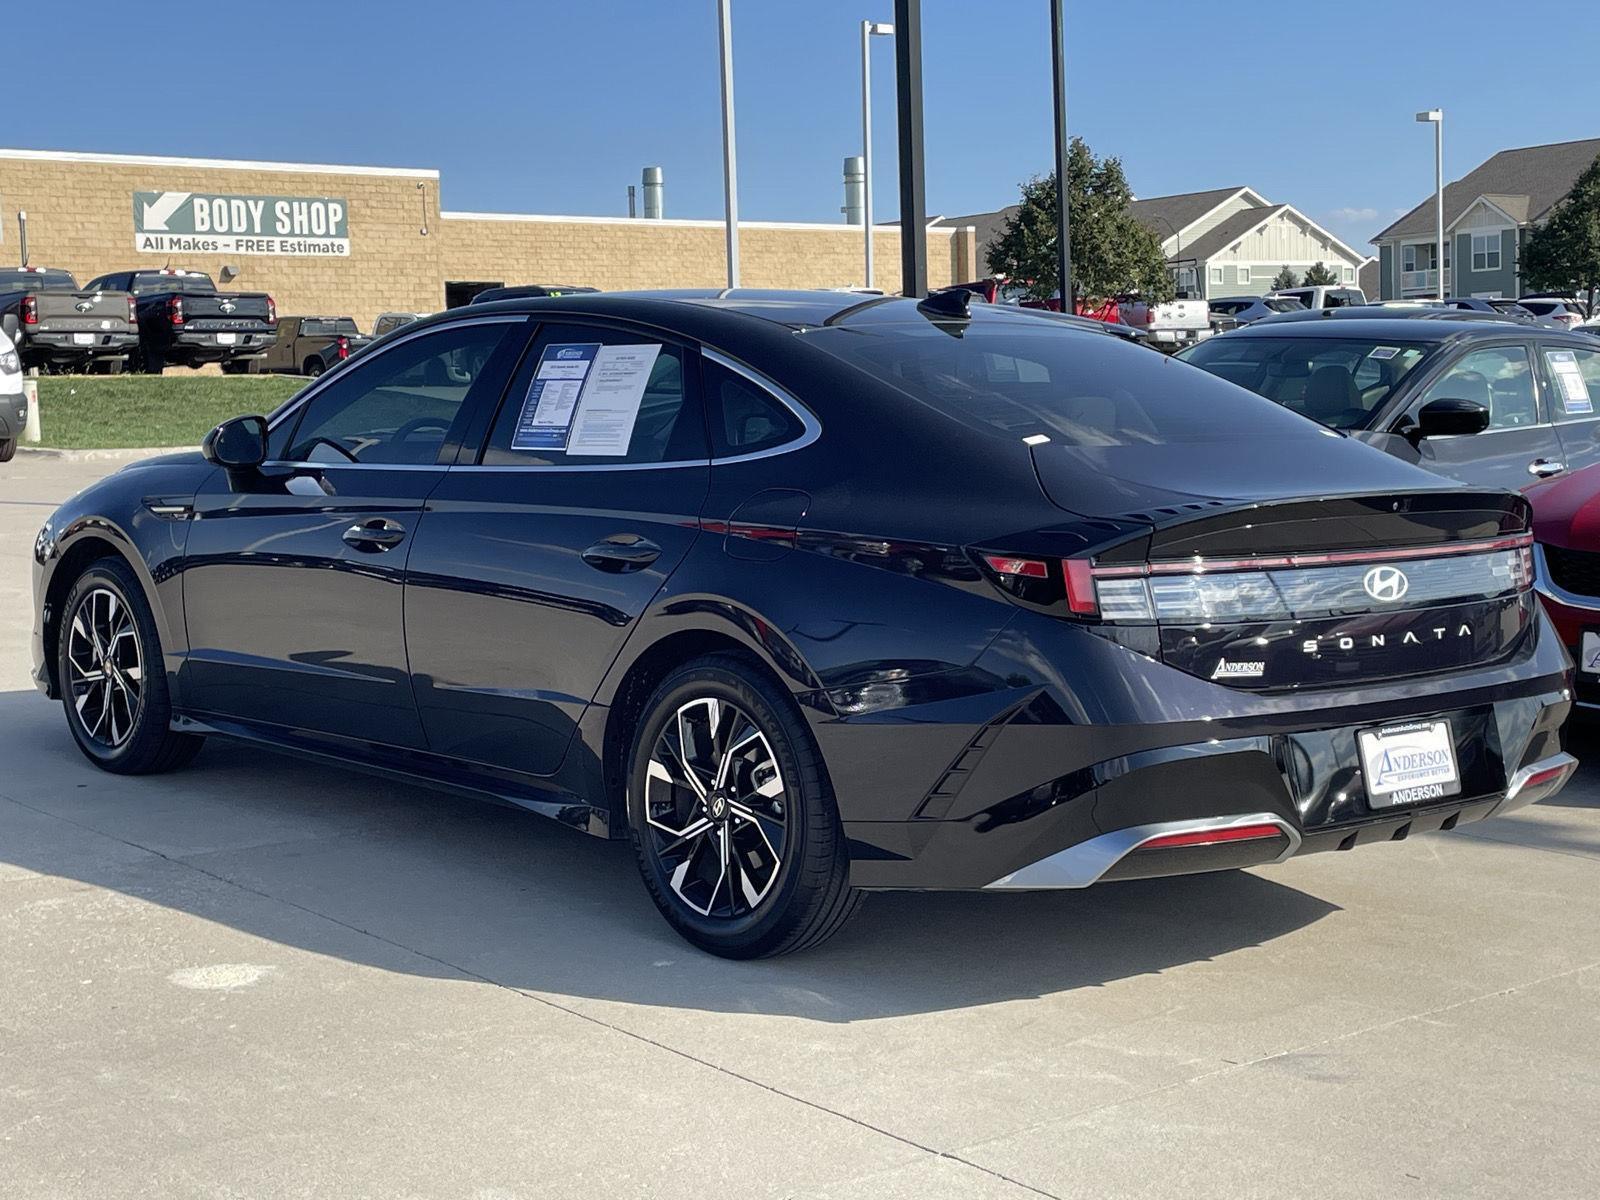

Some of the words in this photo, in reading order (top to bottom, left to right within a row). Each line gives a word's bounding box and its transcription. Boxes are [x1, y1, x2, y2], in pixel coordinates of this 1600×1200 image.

[193, 197, 265, 233] BODY
[275, 200, 343, 235] SHOP
[143, 237, 164, 250] All
[169, 238, 218, 251] Makes
[235, 239, 275, 252] FREE
[280, 240, 345, 253] Estimate
[1303, 624, 1471, 653] SONATA
[1211, 657, 1265, 679] ANDERSON
[1375, 748, 1450, 786] ANDERSON
[1392, 783, 1444, 805] ANDERSON
